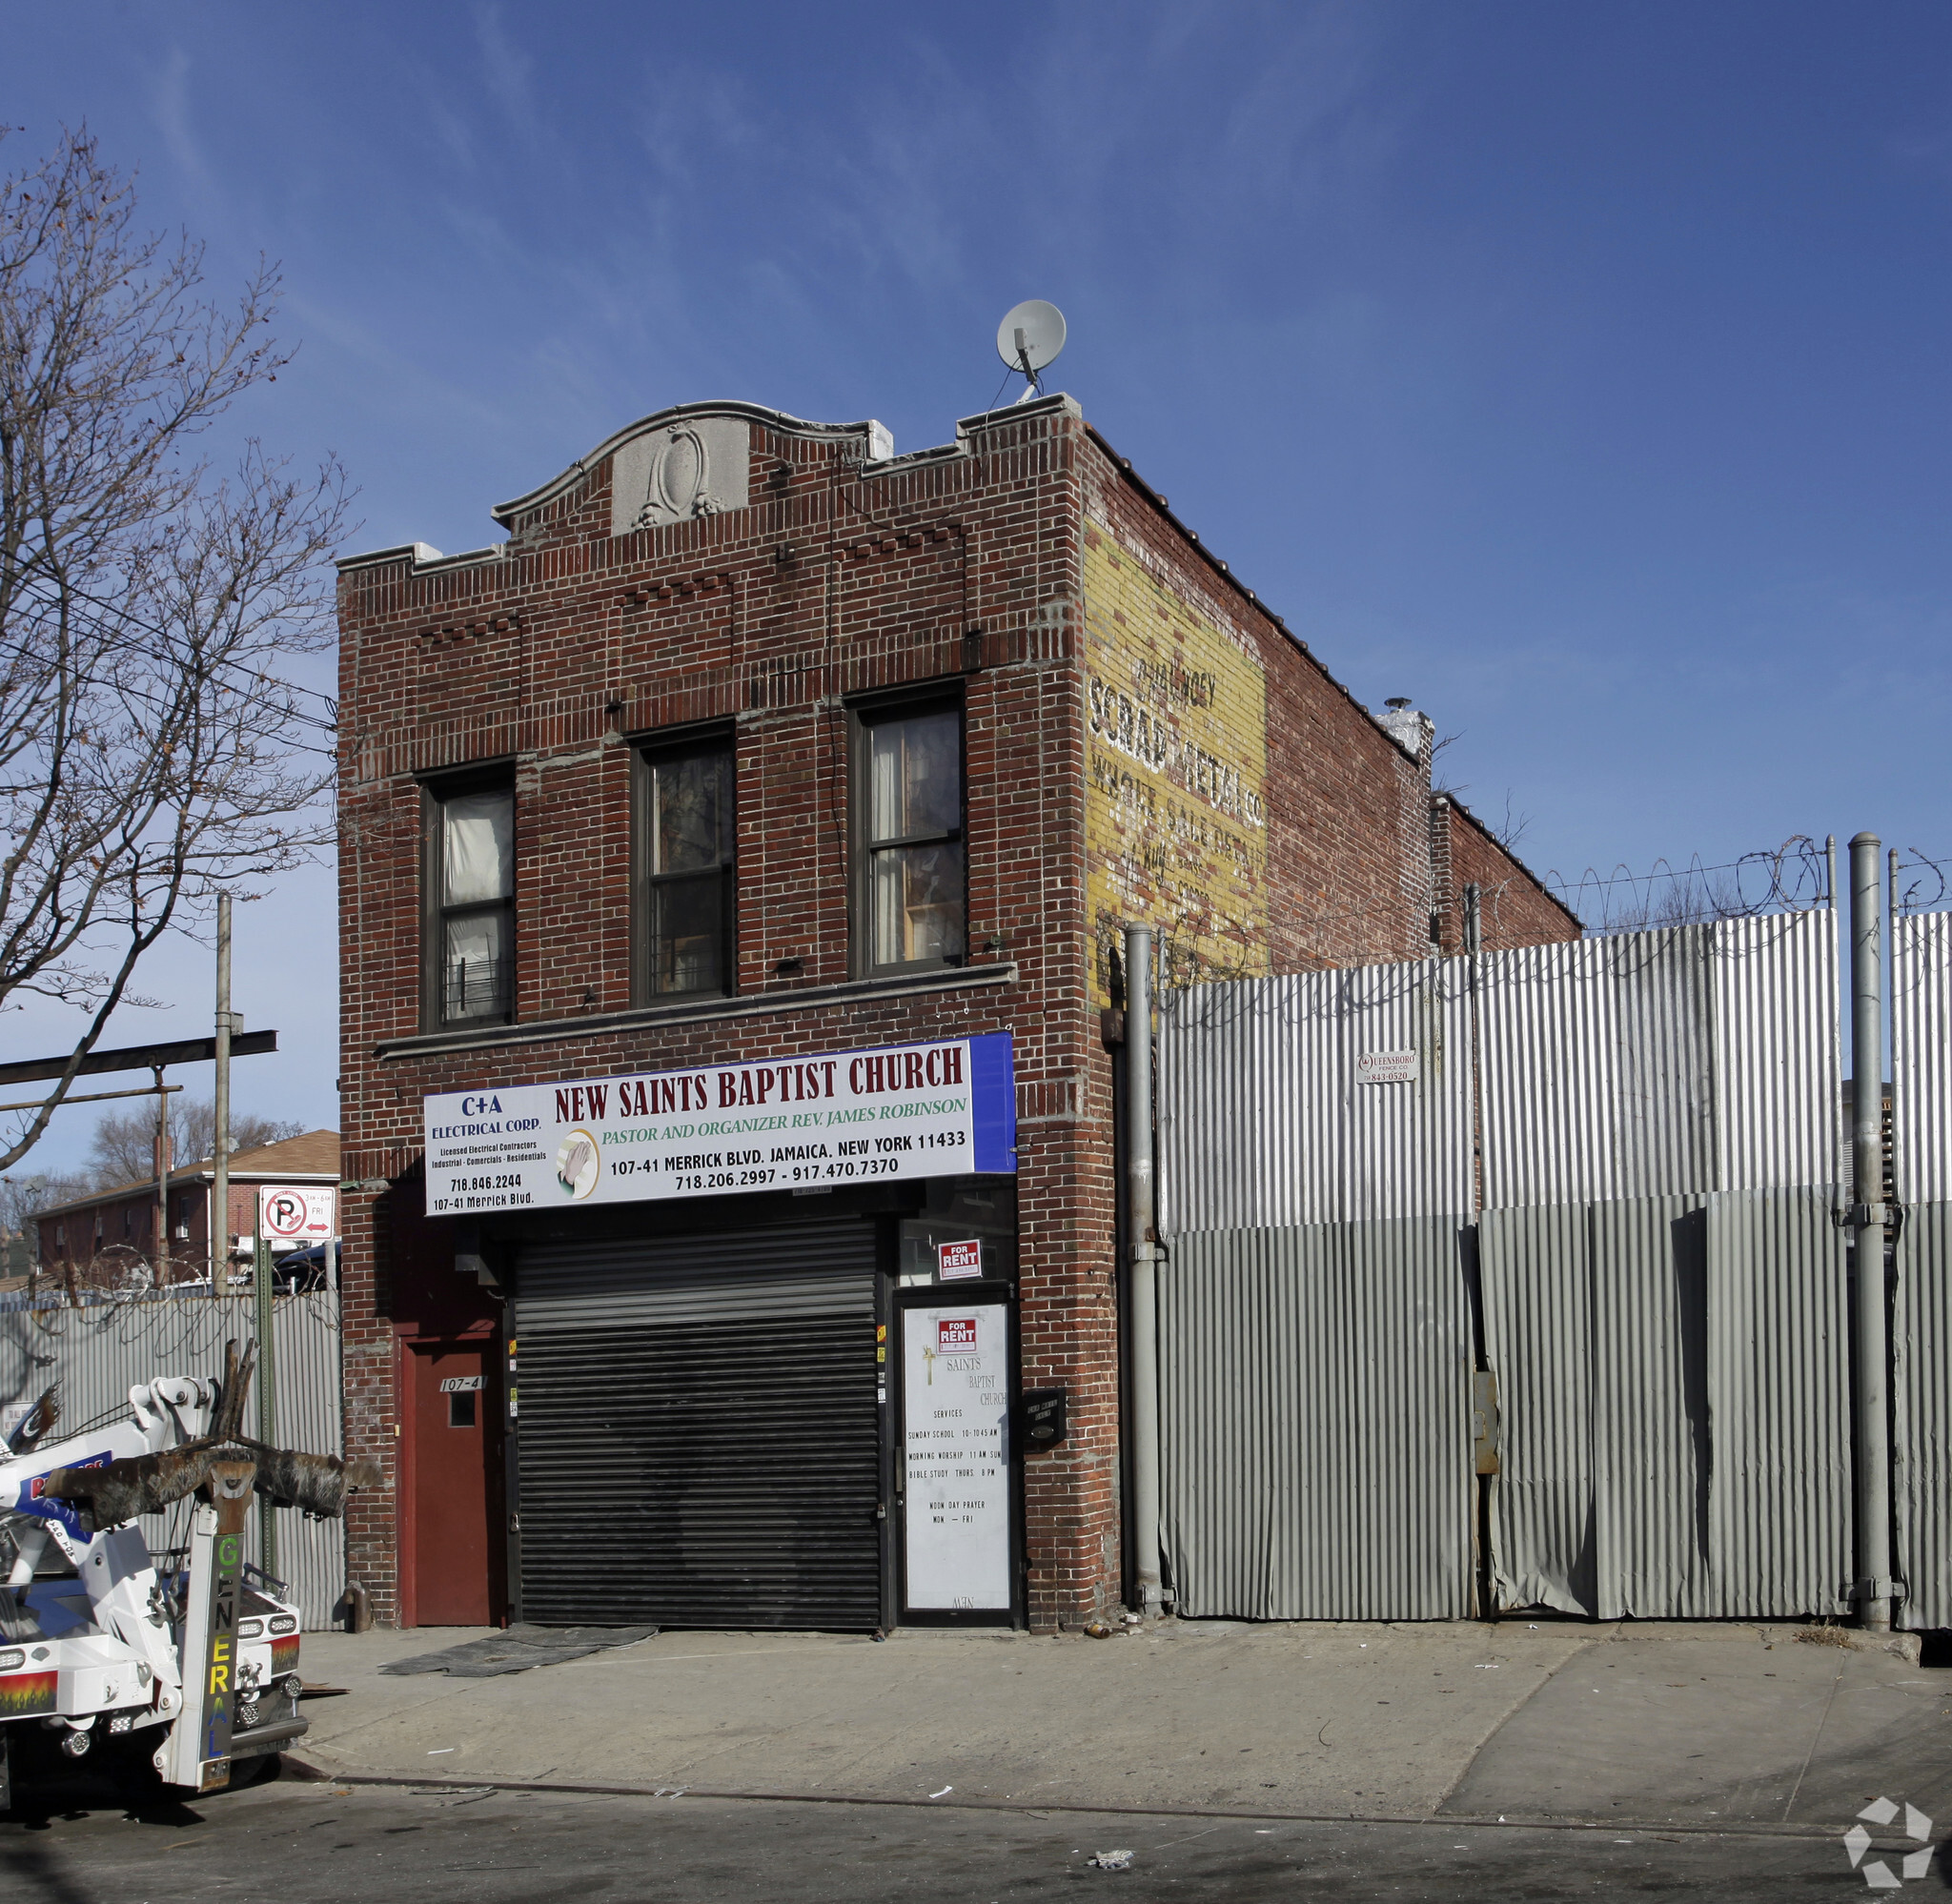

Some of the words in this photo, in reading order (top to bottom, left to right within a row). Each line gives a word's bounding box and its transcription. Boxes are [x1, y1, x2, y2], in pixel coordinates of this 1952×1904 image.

[1372, 1072, 1408, 1081] 843-0520
[555, 1084, 609, 1123] NEW
[619, 1073, 708, 1118] SAINTS
[718, 1061, 837, 1108] BAPTIST
[848, 1047, 964, 1096] CHURCH
[432, 1122, 503, 1139] ELECTRICAL
[505, 1118, 541, 1133] CORP.
[601, 1127, 658, 1145] PASTOR
[661, 1124, 695, 1141] AND
[698, 1115, 787, 1138] ORGANIZER
[791, 1112, 824, 1128] REV.
[825, 1106, 876, 1128] JAMES
[879, 1098, 967, 1120] ROBINSON
[440, 1146, 467, 1156] Licensed
[468, 1144, 498, 1154] Electrical
[499, 1142, 537, 1151] Contractors
[611, 1159, 659, 1176] 107-41
[664, 1153, 722, 1171] MERRICK
[726, 1149, 764, 1166] BLVD.
[838, 1140, 869, 1157] NEW
[874, 1136, 913, 1153] YORK
[918, 1131, 966, 1148] 11433
[432, 1159, 462, 1168] Industrial
[466, 1155, 501, 1165] Comercials
[507, 1152, 546, 1163] Residentials
[676, 1169, 776, 1190] 718.206.2997
[793, 1158, 899, 1181] 917.470.7370
[451, 1174, 521, 1191] 718.846.2244
[434, 1198, 463, 1210] 107-41
[467, 1194, 506, 1208] Merrick
[510, 1192, 535, 1205] Blvd.
[951, 1246, 968, 1255] FOR
[944, 1252, 977, 1267] RENT
[941, 1330, 975, 1343] RENT
[947, 1358, 982, 1371] SAINTS
[969, 1375, 996, 1388] BAPTIST
[981, 1392, 1006, 1406] CHURCH
[934, 1409, 963, 1418] SERVICES
[933, 1430, 954, 1439] SCHOOL
[208, 1537, 238, 1758] GENERAL
